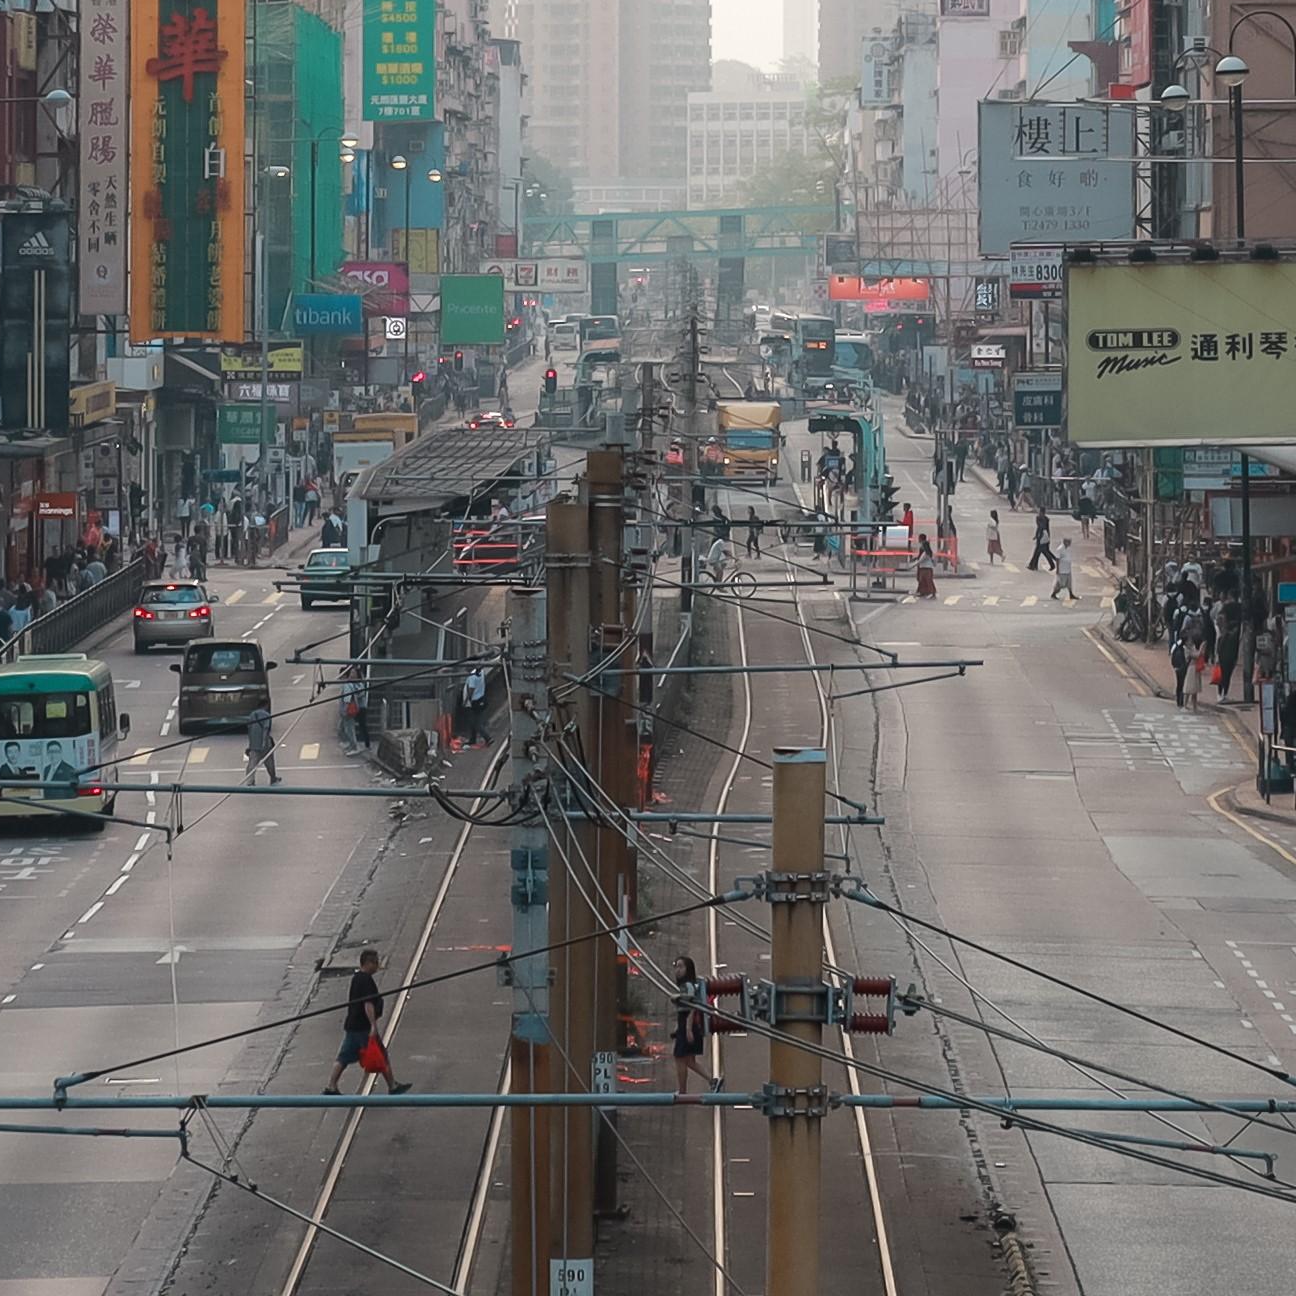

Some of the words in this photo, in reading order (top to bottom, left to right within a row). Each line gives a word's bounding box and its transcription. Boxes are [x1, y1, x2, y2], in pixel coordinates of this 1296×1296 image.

[1014, 116, 1098, 154] 樓上
[19, 247, 55, 255] adidas
[295, 307, 353, 325] tibank
[1095, 332, 1134, 348] TOM
[1142, 331, 1173, 347] LEE
[1097, 350, 1182, 379] Music
[558, 1268, 585, 1282] 590
